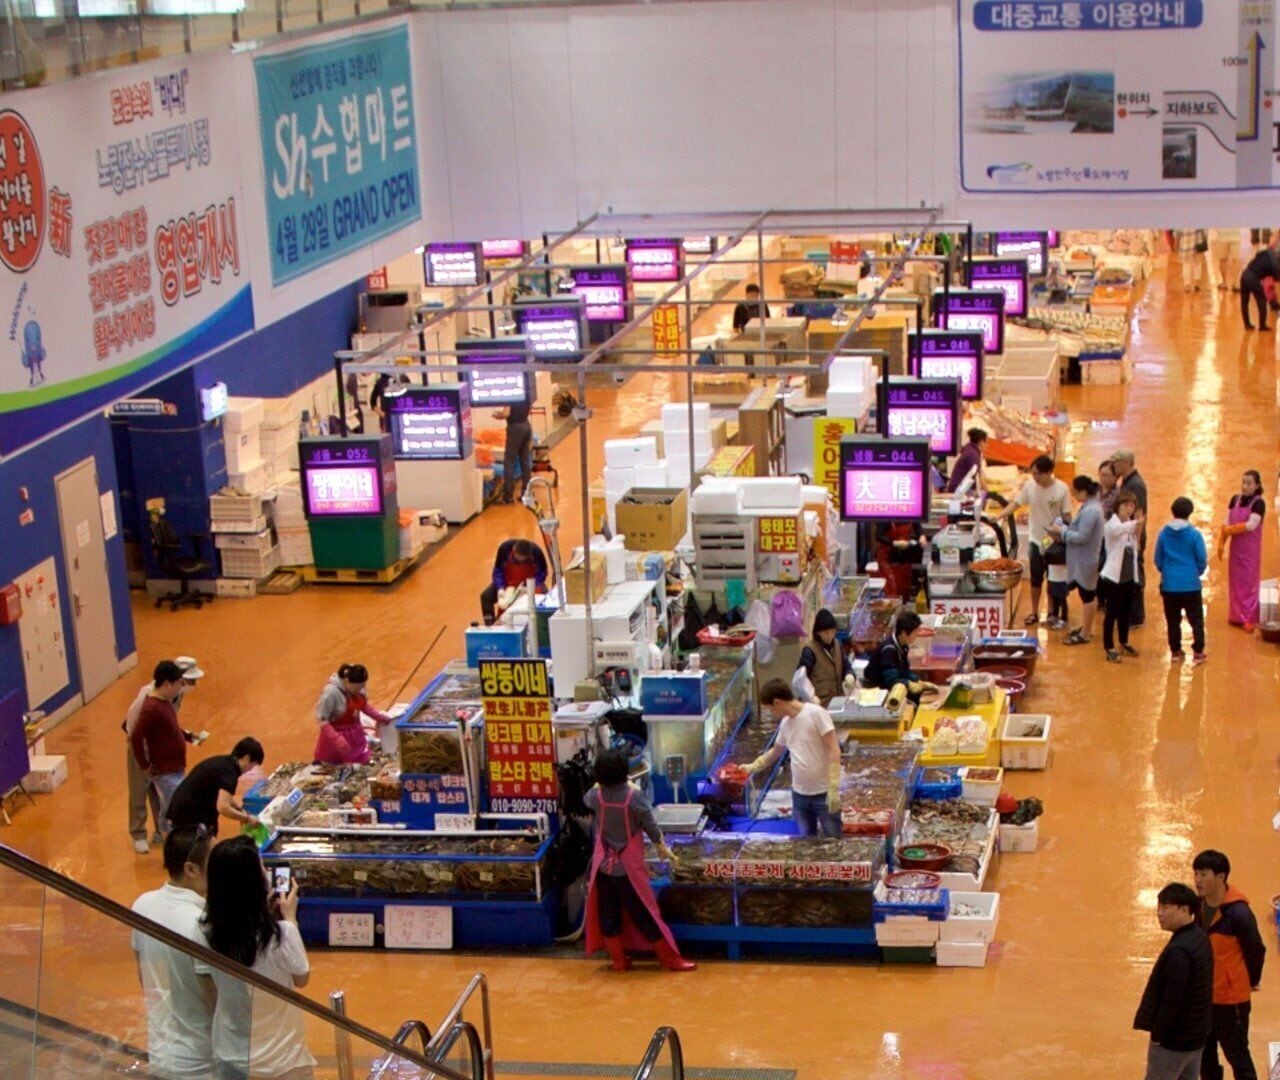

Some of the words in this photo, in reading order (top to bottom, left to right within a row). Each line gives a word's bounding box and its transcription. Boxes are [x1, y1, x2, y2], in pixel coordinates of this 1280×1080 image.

[990, 1, 1083, 28] 대중교통
[1093, 0, 1185, 26] 이용안내
[1222, 58, 1248, 66] 100m
[111, 81, 154, 126] 도심속의
[1117, 92, 1150, 104] 현위치
[1166, 101, 1218, 115] 지하보도
[96, 118, 211, 195] 노량진수산물도매시장
[276, 216, 299, 264] 4월
[301, 203, 330, 254] 29일
[332, 184, 379, 241] GRAND
[382, 168, 416, 219] OPEN
[155, 196, 241, 308] 영업개시
[923, 391, 943, 400] 045
[346, 448, 369, 460] 052
[854, 451, 874, 462] 냉동
[891, 451, 915, 461] 044
[760, 518, 796, 534] 동태포
[760, 535, 797, 551] 대구포
[481, 661, 547, 695] 쌍둥이네
[486, 722, 523, 744] 킹크랩
[526, 721, 551, 743] 대게
[488, 761, 526, 783] 랍스타
[529, 761, 554, 782] 전복
[491, 798, 558, 814] 010-9090-2761
